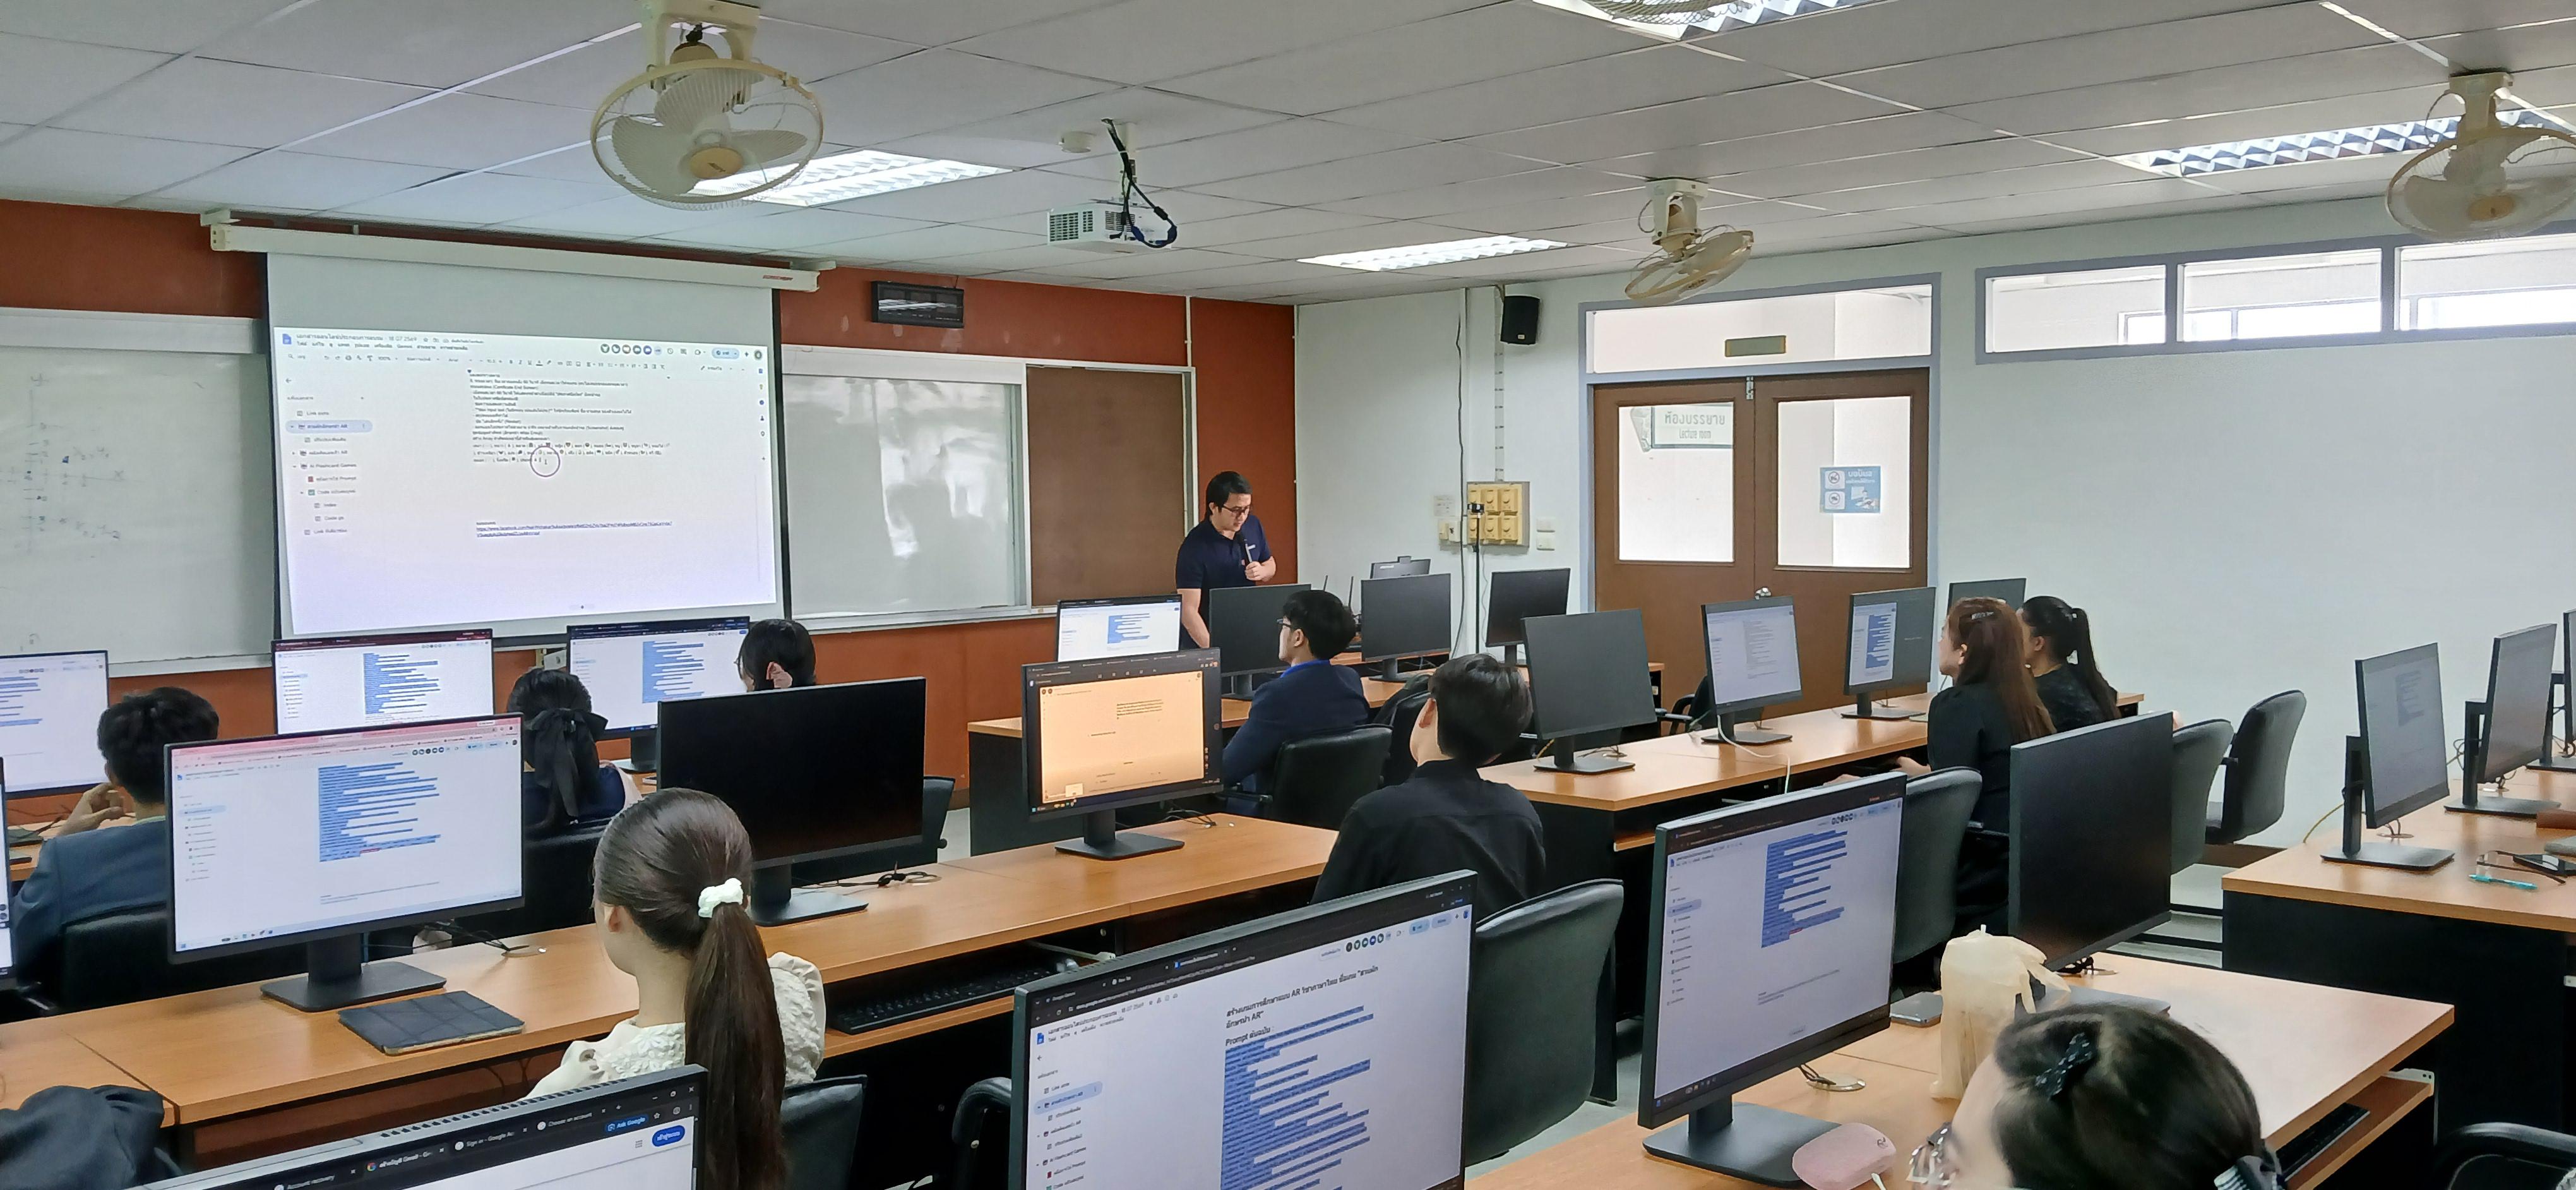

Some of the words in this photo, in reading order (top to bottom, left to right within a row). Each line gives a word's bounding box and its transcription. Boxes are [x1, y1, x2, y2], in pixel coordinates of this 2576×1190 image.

[1664, 411, 1726, 425] ห้องบรรยาย
[1679, 430, 1698, 439] Lecture
[1291, 988, 1301, 997] AR
[1225, 1032, 1249, 1047] Prompt
